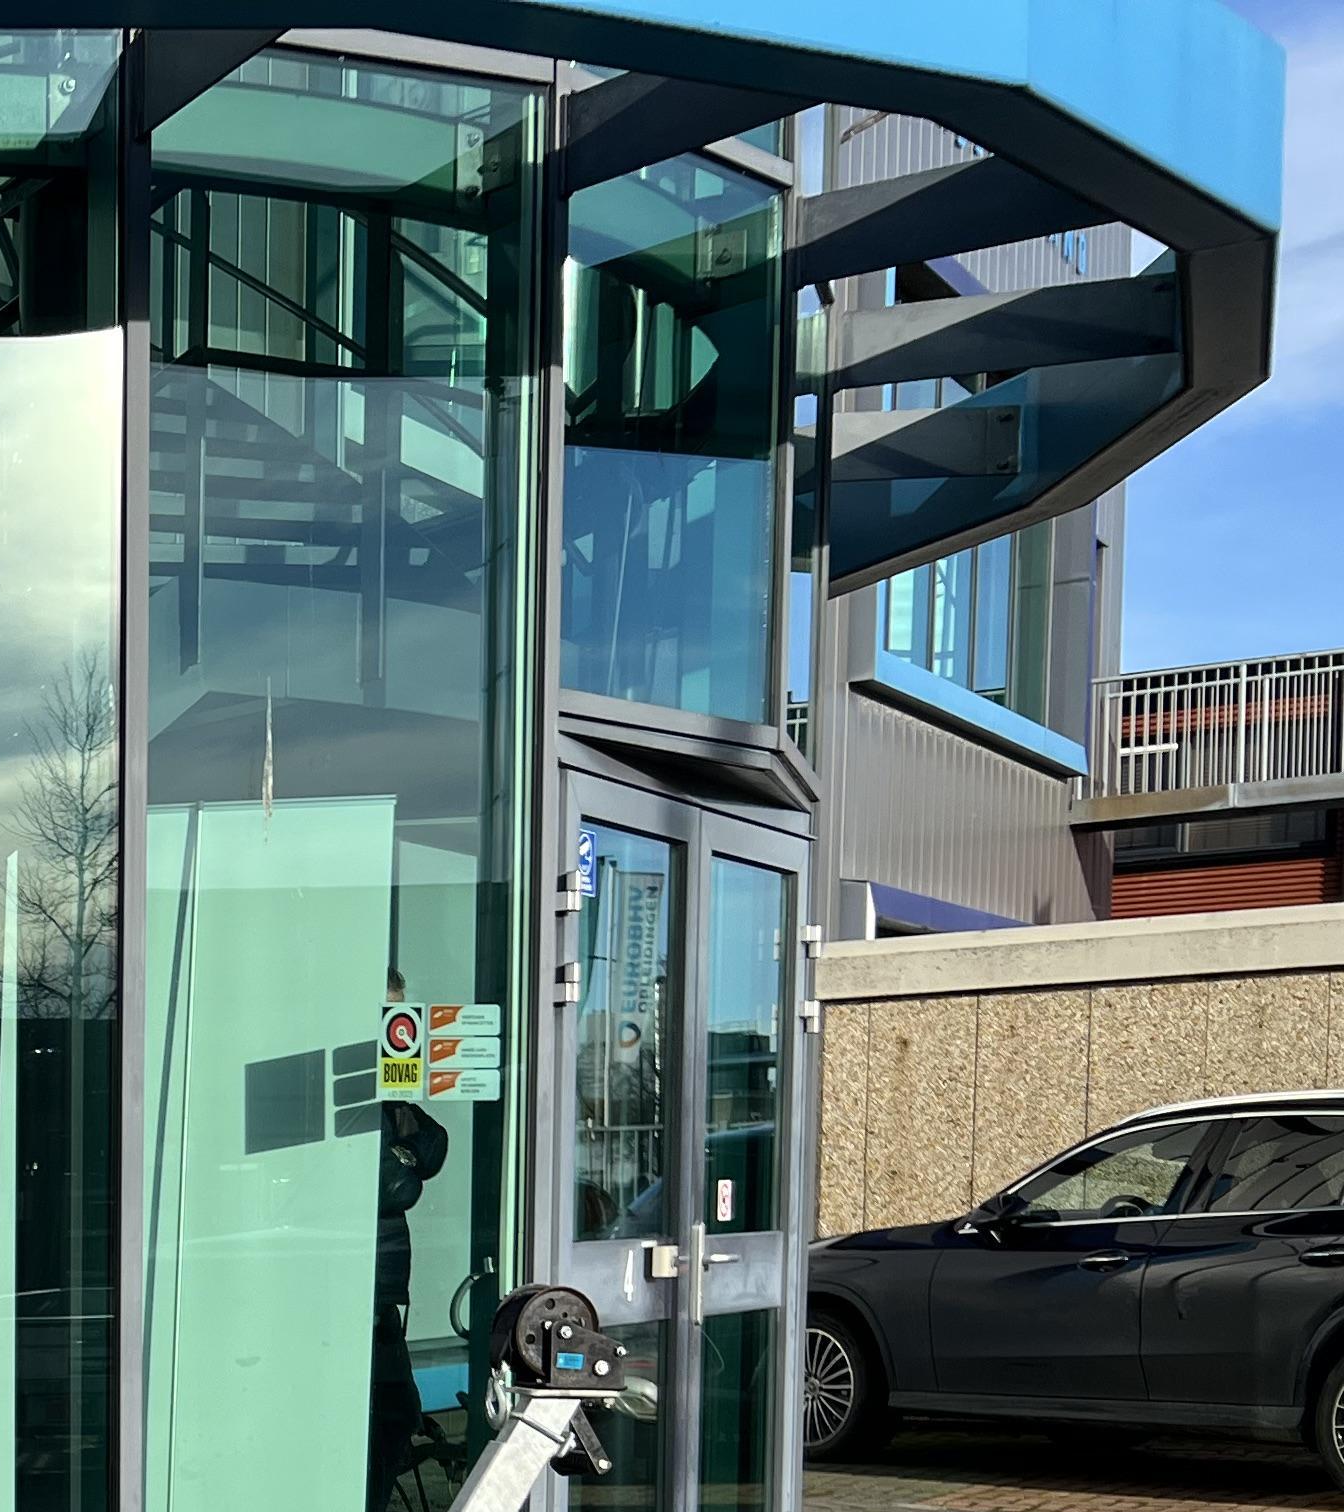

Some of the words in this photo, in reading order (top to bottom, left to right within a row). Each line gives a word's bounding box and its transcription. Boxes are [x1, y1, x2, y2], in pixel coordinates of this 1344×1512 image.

[620, 886, 643, 1013] EUROBHV
[638, 886, 659, 1013] OPLEIDINGEN
[383, 1063, 418, 1083] BOVAG
